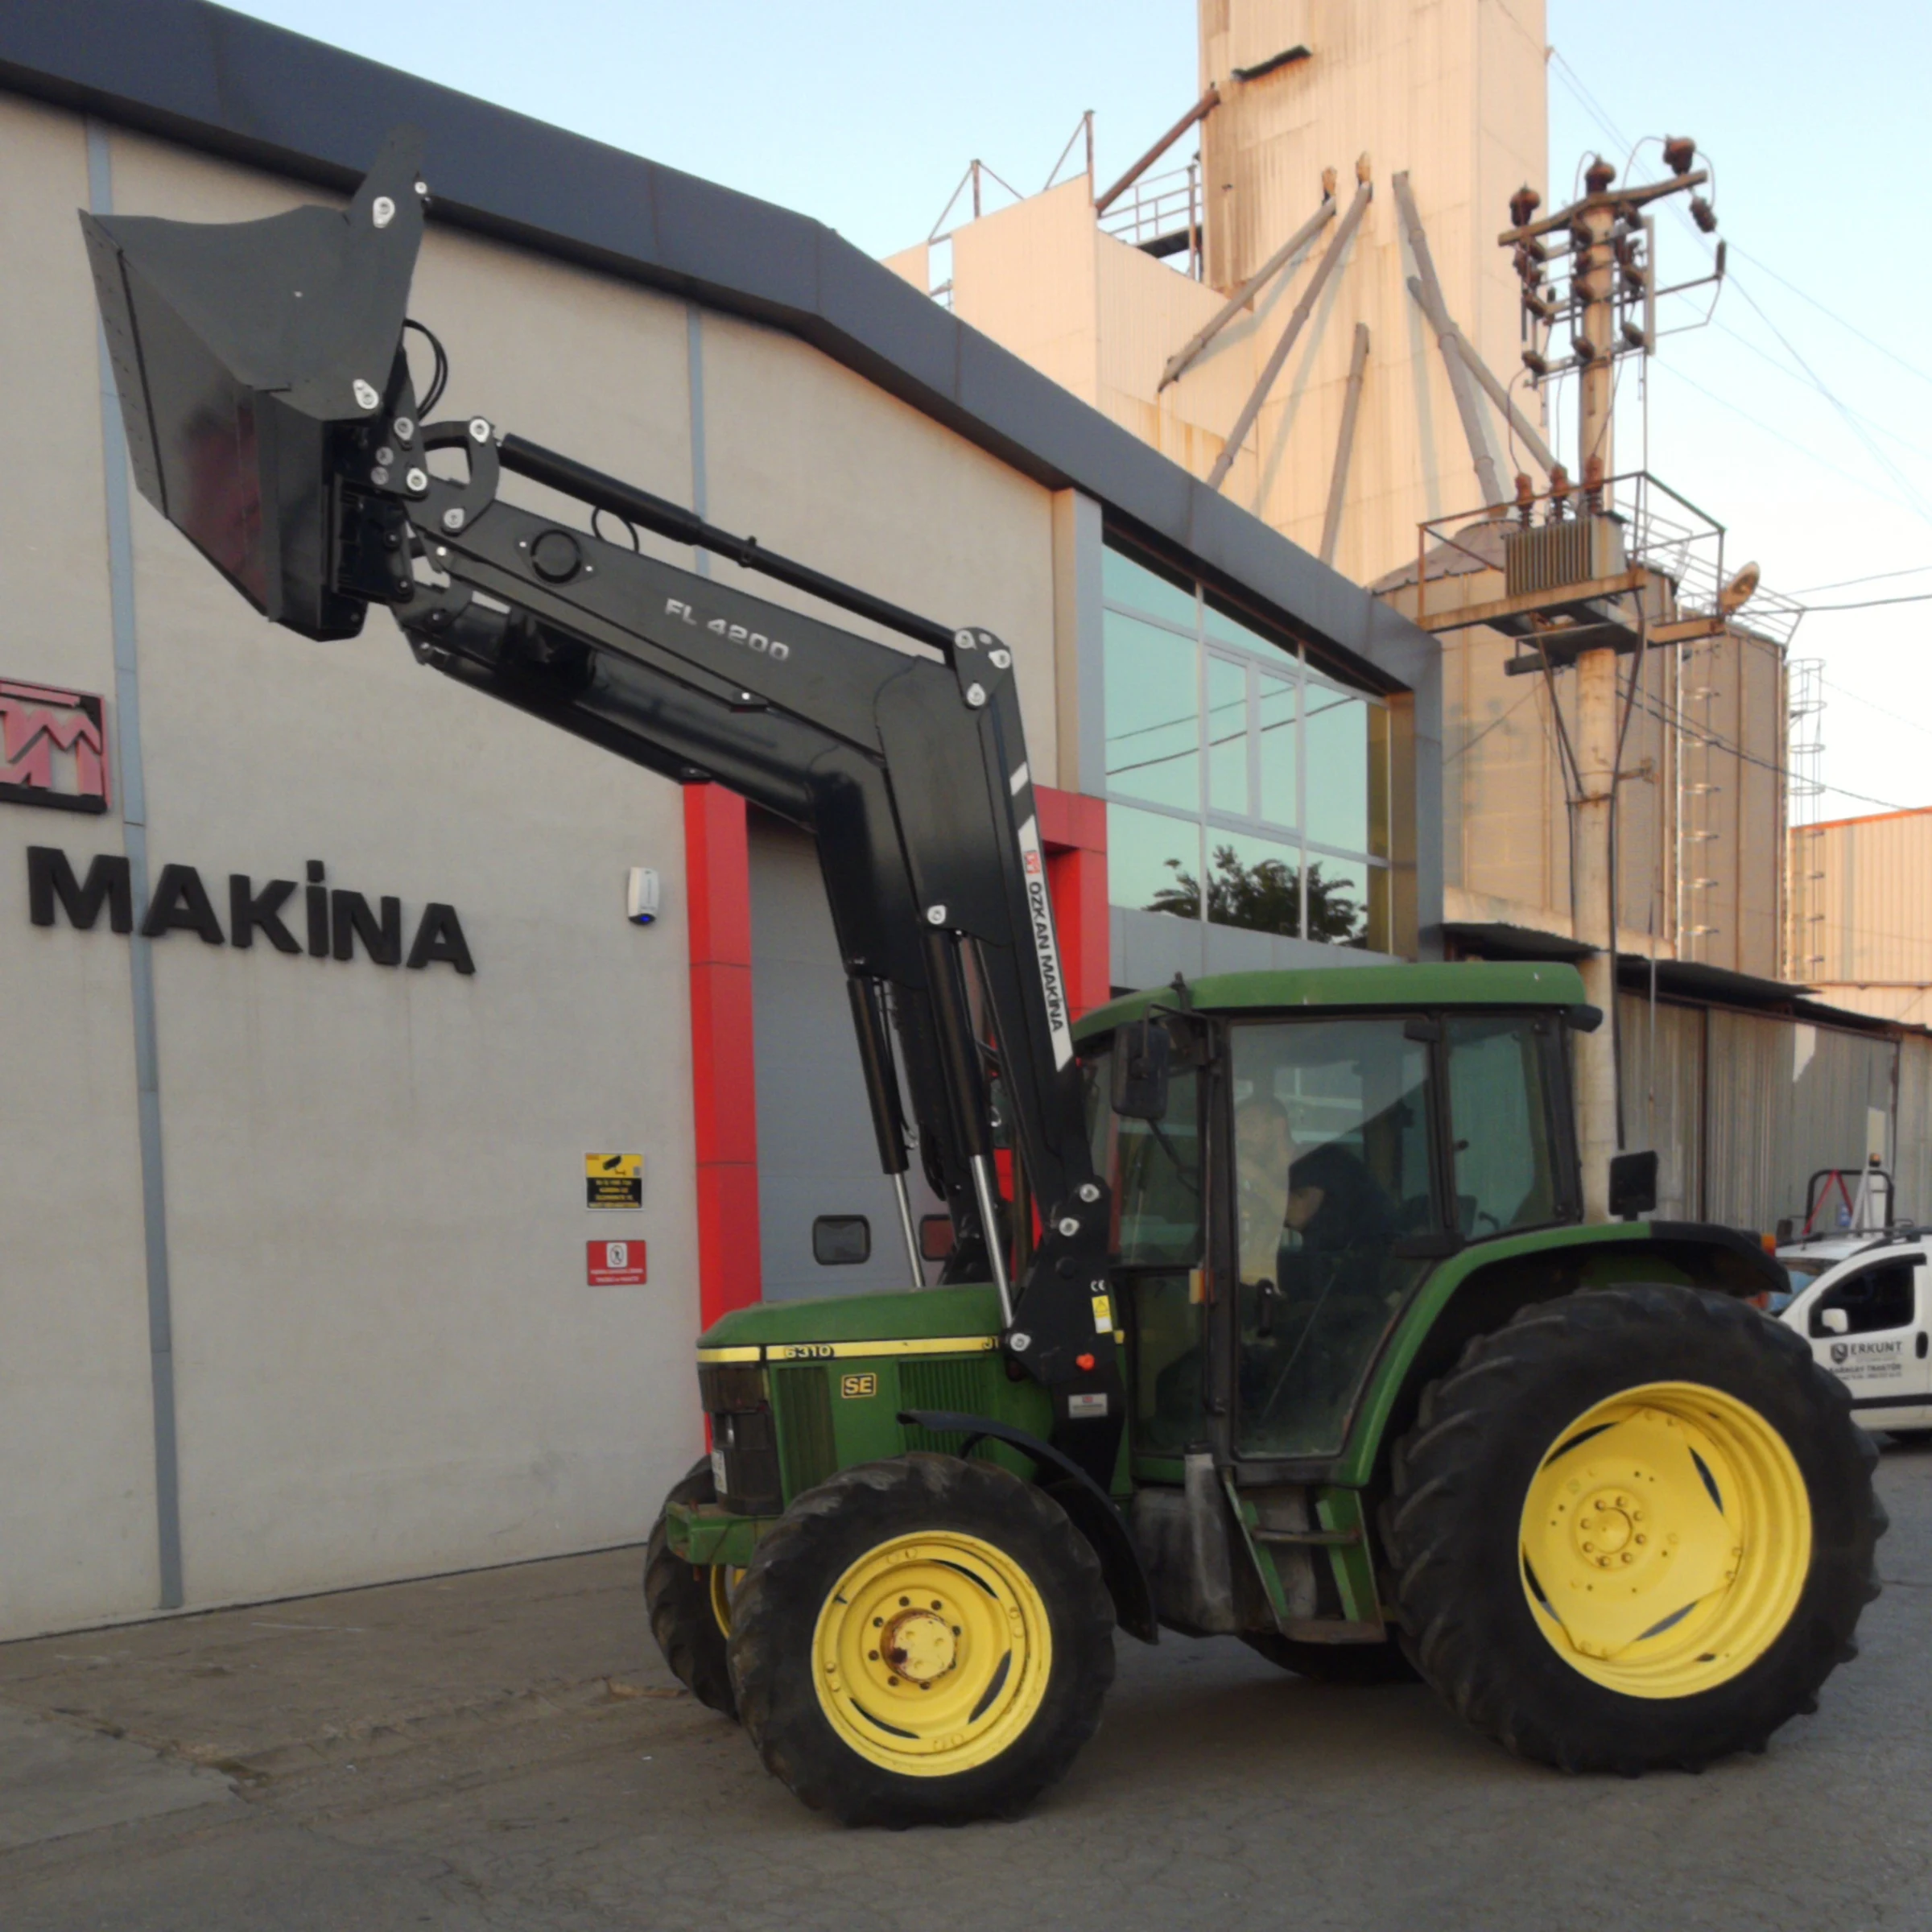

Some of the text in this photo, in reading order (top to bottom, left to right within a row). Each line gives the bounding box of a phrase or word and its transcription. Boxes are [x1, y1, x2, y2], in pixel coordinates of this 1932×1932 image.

[665, 598, 790, 661] FL 4200
[27, 845, 477, 975] MAKİNA
[784, 1344, 835, 1359] 6310
[1850, 1341, 1902, 1355] ERKUNT
[844, 1375, 873, 1395] SE
